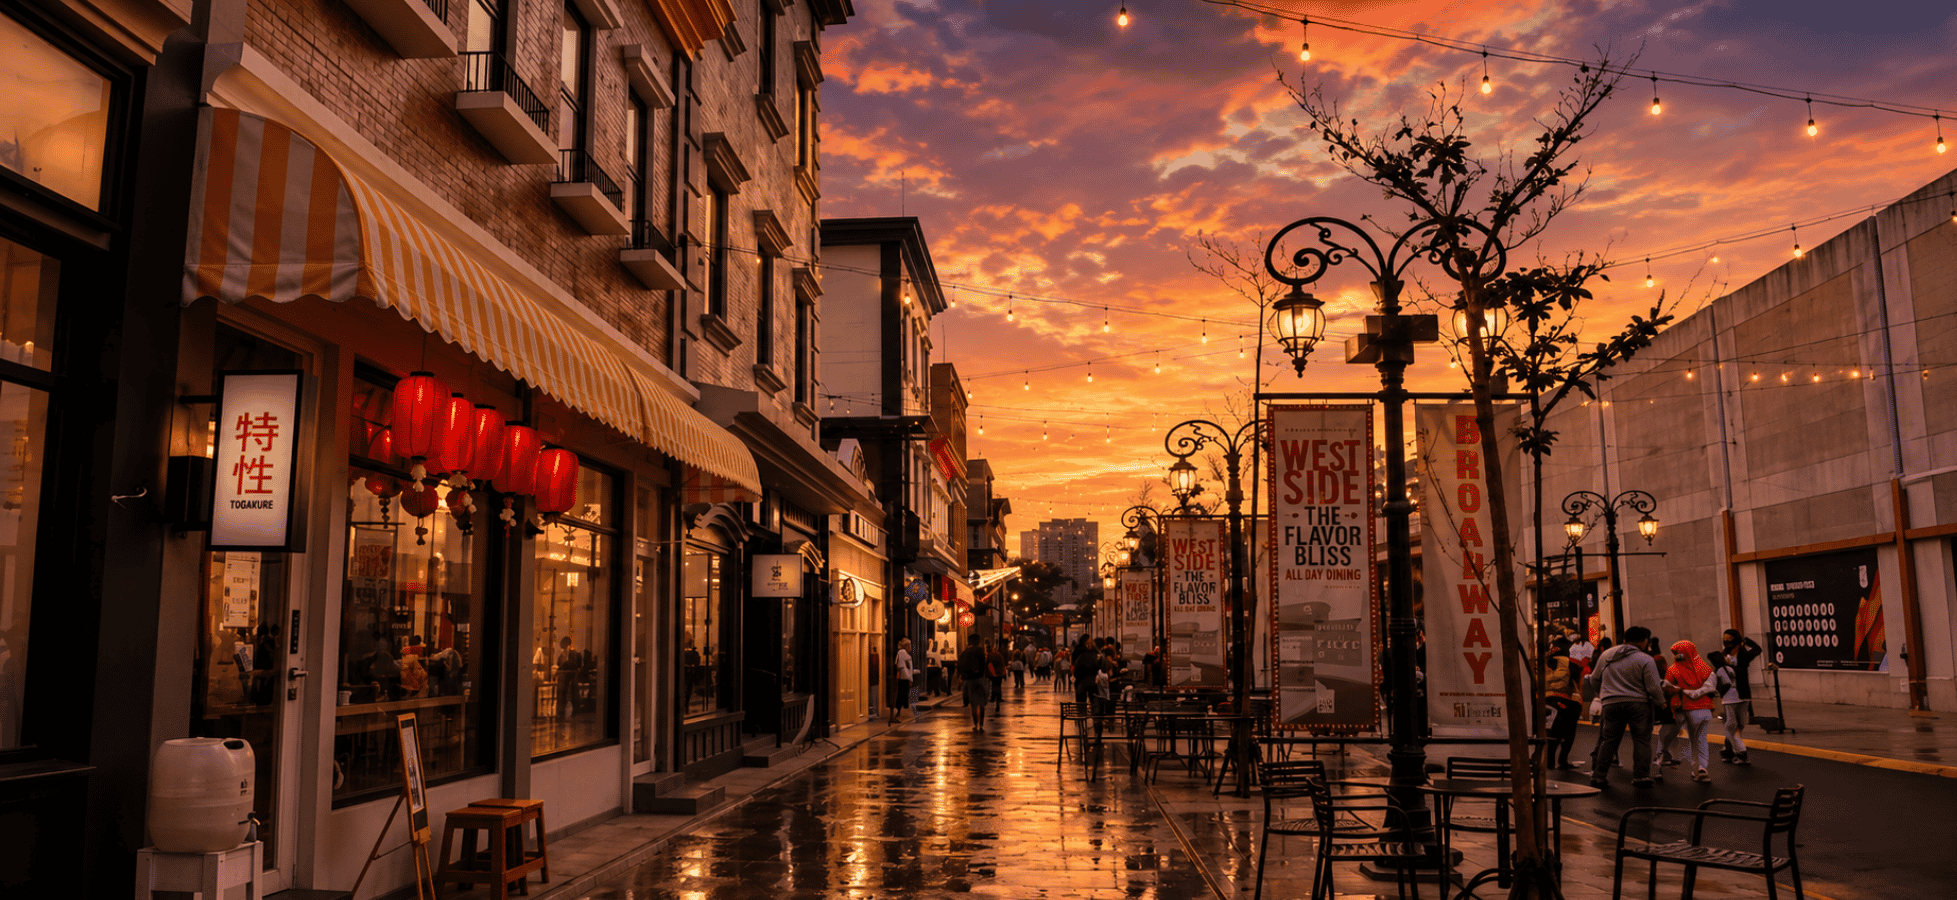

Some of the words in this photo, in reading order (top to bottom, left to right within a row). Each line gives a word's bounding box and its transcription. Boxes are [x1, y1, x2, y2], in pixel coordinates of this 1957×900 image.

[232, 411, 279, 496] 特性
[1280, 439, 1361, 472] WEST
[1283, 469, 1361, 505] SIDE
[230, 500, 274, 509] TOGAKURE
[1304, 506, 1341, 525] THE
[1285, 526, 1362, 546] FLAVOR
[1172, 539, 1216, 555] WEST
[1295, 546, 1351, 566] BLISS
[1174, 553, 1215, 571] SIDE
[1184, 571, 1205, 582] THE
[1285, 569, 1303, 580] ALL
[1305, 569, 1323, 580] DAY
[1326, 569, 1361, 580] DINING
[1179, 594, 1210, 605] BLISS
